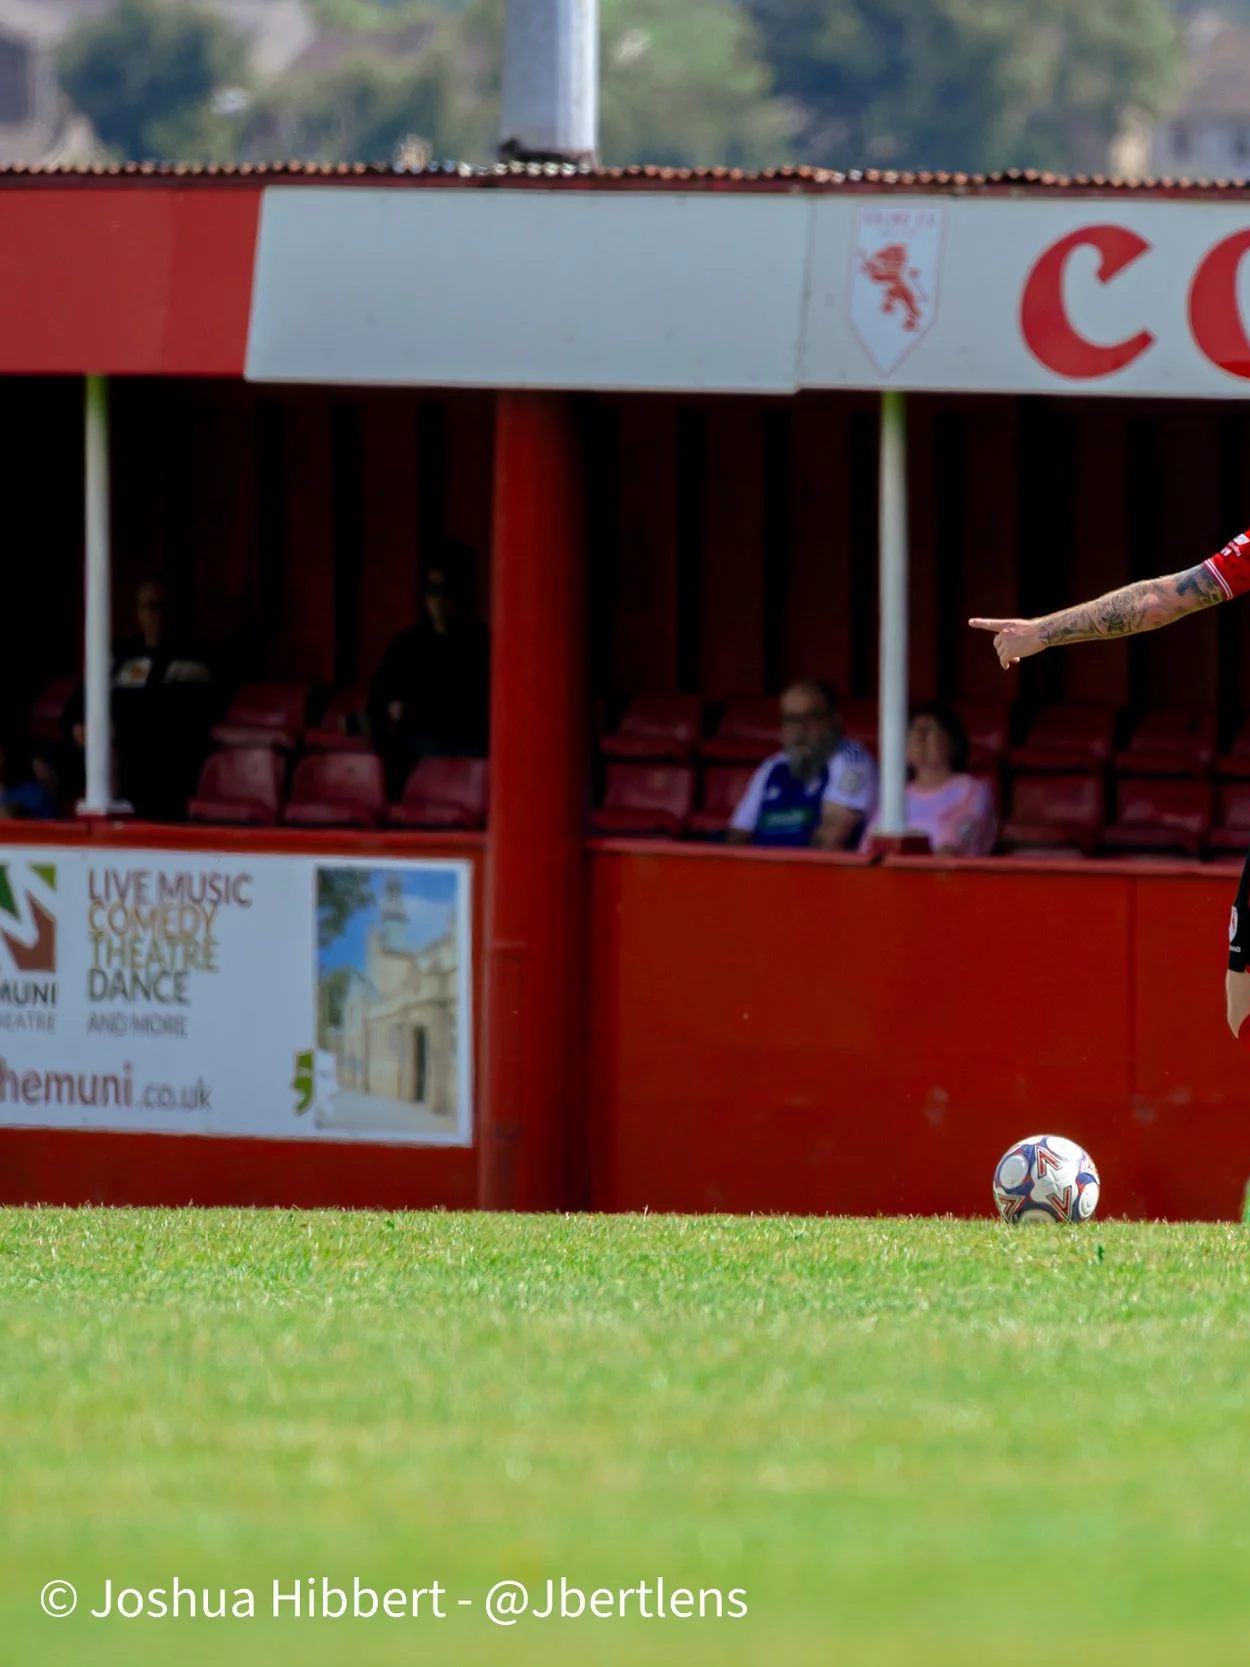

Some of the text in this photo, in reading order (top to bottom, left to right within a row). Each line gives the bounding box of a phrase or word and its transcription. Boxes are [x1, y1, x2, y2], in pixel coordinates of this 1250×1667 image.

[88, 869, 254, 909] LIVE MUSIC
[88, 899, 219, 940] COMEDY
[89, 930, 220, 974] THEATRE
[88, 968, 191, 1006] DANCE
[87, 1012, 188, 1038] AND MORE
